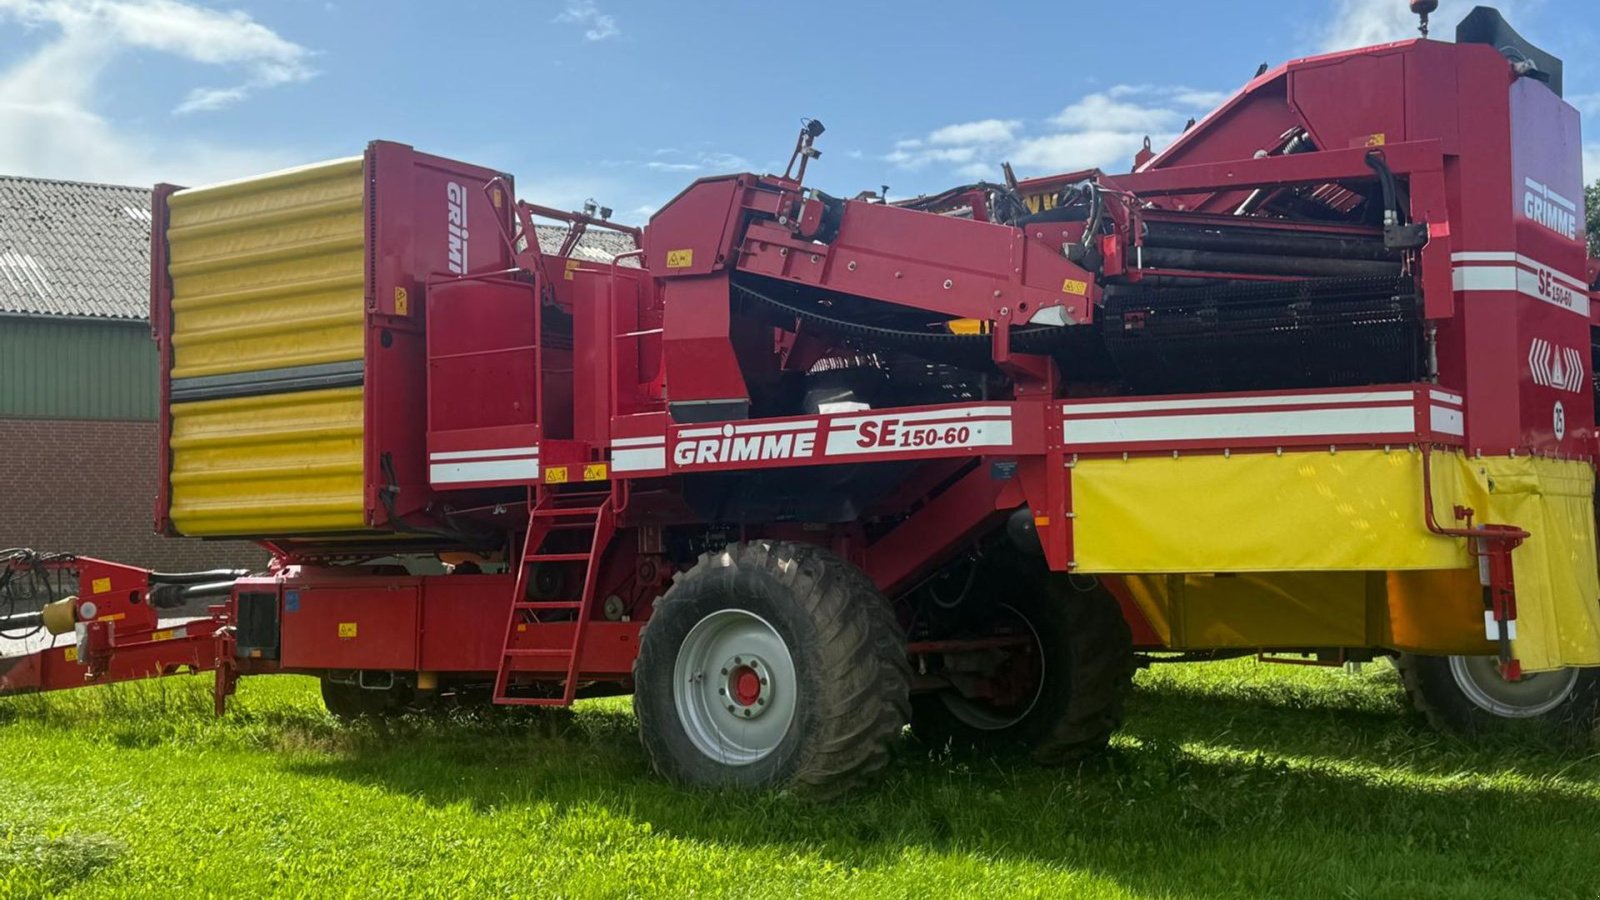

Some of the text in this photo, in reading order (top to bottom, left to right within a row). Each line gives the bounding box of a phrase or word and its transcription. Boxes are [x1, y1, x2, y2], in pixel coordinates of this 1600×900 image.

[1524, 184, 1576, 241] GRIMME
[1538, 268, 1573, 308] SE 150-60
[856, 419, 970, 448] SE 150-60
[1555, 407, 1563, 433] 25
[673, 423, 816, 465] GRIMME
